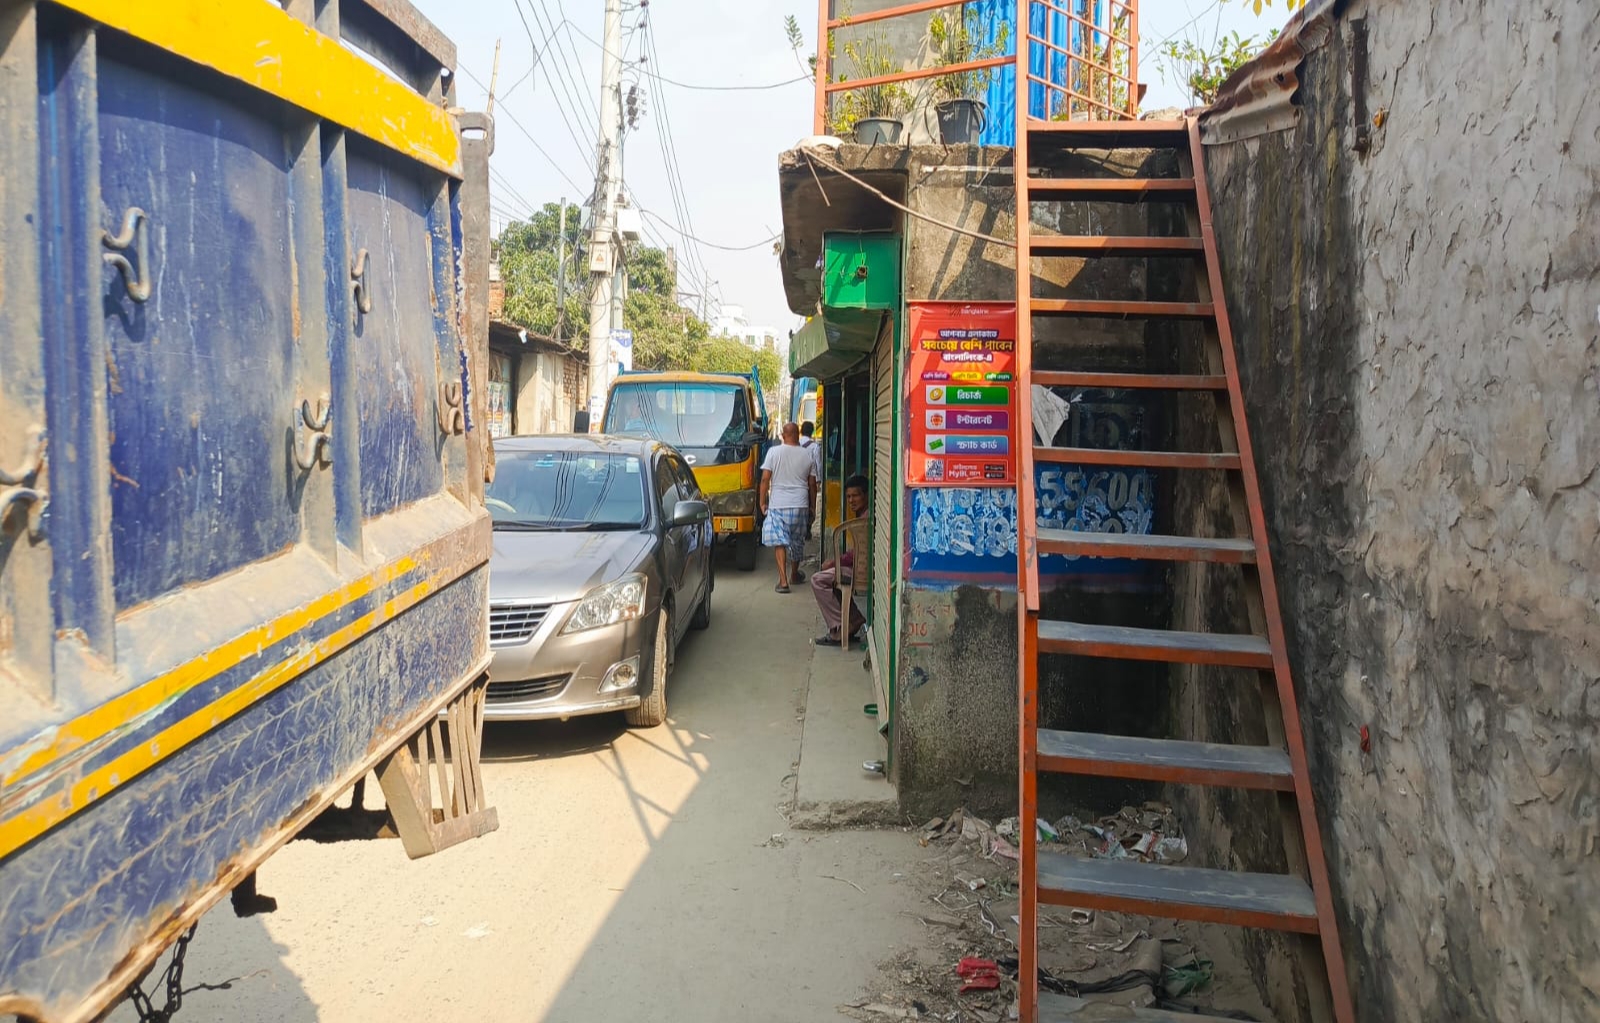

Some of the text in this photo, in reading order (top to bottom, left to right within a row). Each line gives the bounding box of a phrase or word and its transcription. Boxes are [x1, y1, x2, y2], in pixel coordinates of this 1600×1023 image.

[940, 330, 966, 338] আপনার
[922, 339, 1013, 351] সবচেয়ে বেশি পাবেন
[957, 389, 982, 400] রিচার্জ
[956, 414, 993, 425] ইন্টারনেট
[980, 439, 998, 450] কার্ড
